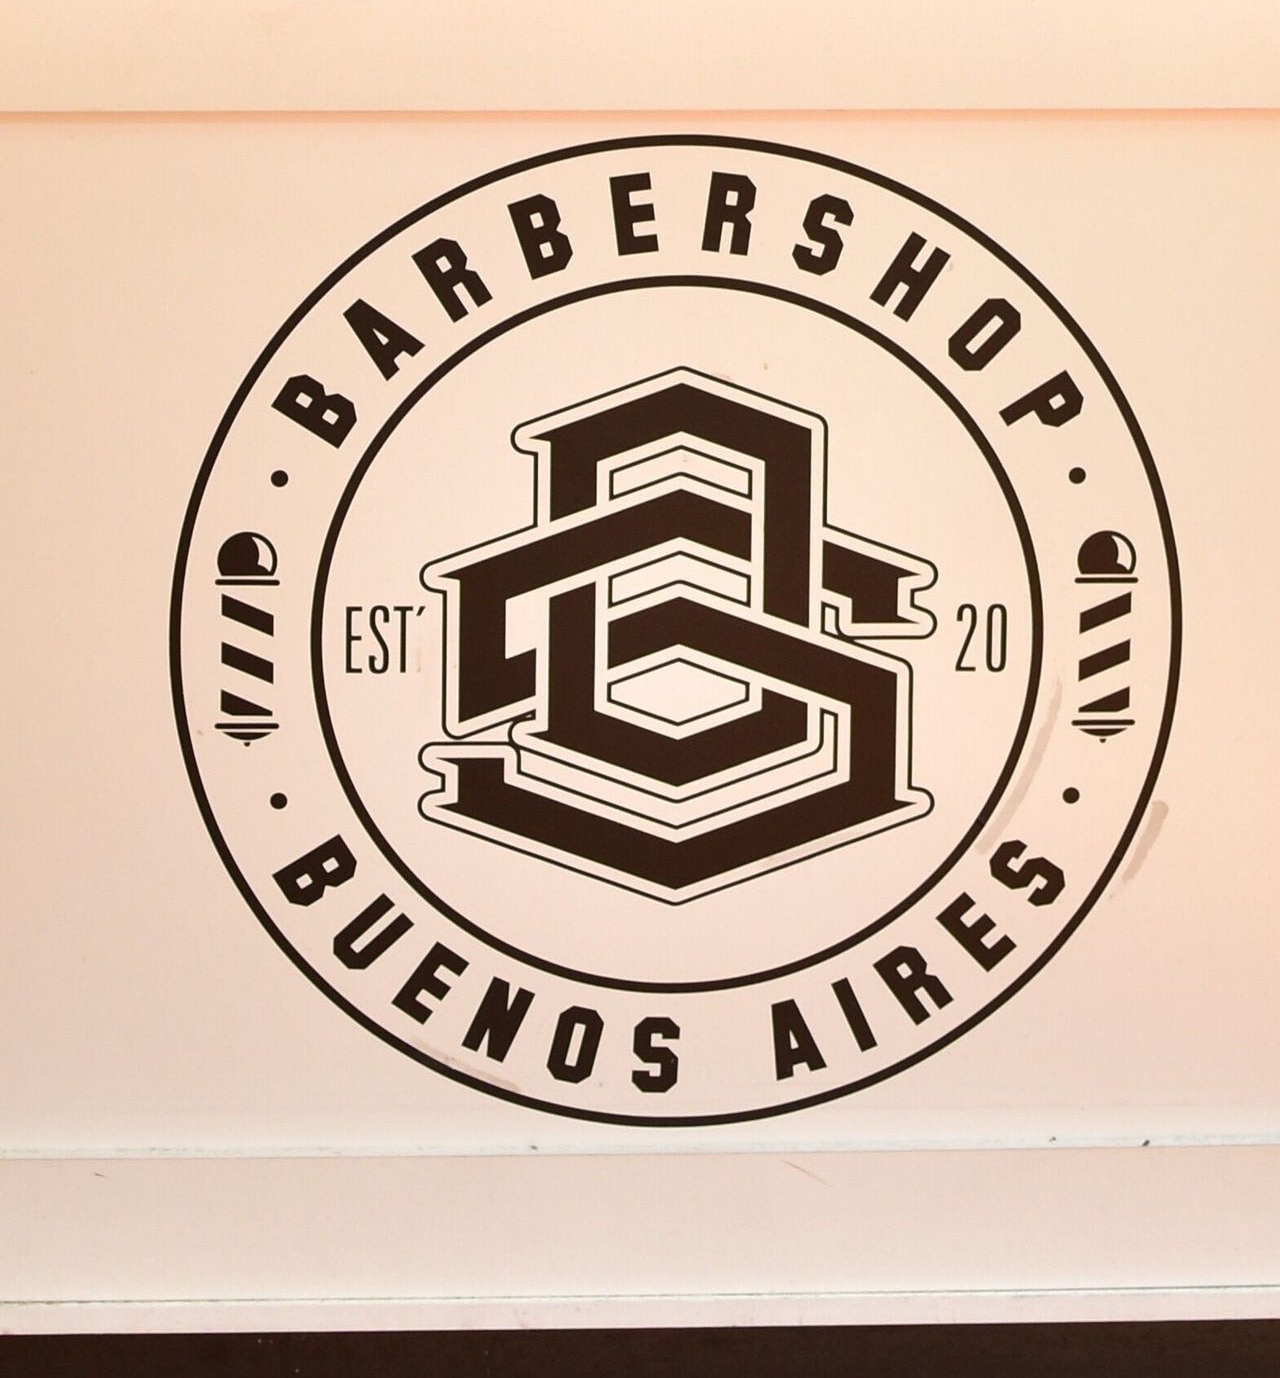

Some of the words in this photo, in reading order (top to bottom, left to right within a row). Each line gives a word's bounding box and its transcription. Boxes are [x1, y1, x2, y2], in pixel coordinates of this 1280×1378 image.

[270, 170, 1085, 452] BARBERSHOP
[953, 602, 1010, 674] 20
[270, 832, 683, 1095] BUENOS
[771, 837, 1068, 1082] AIRES
